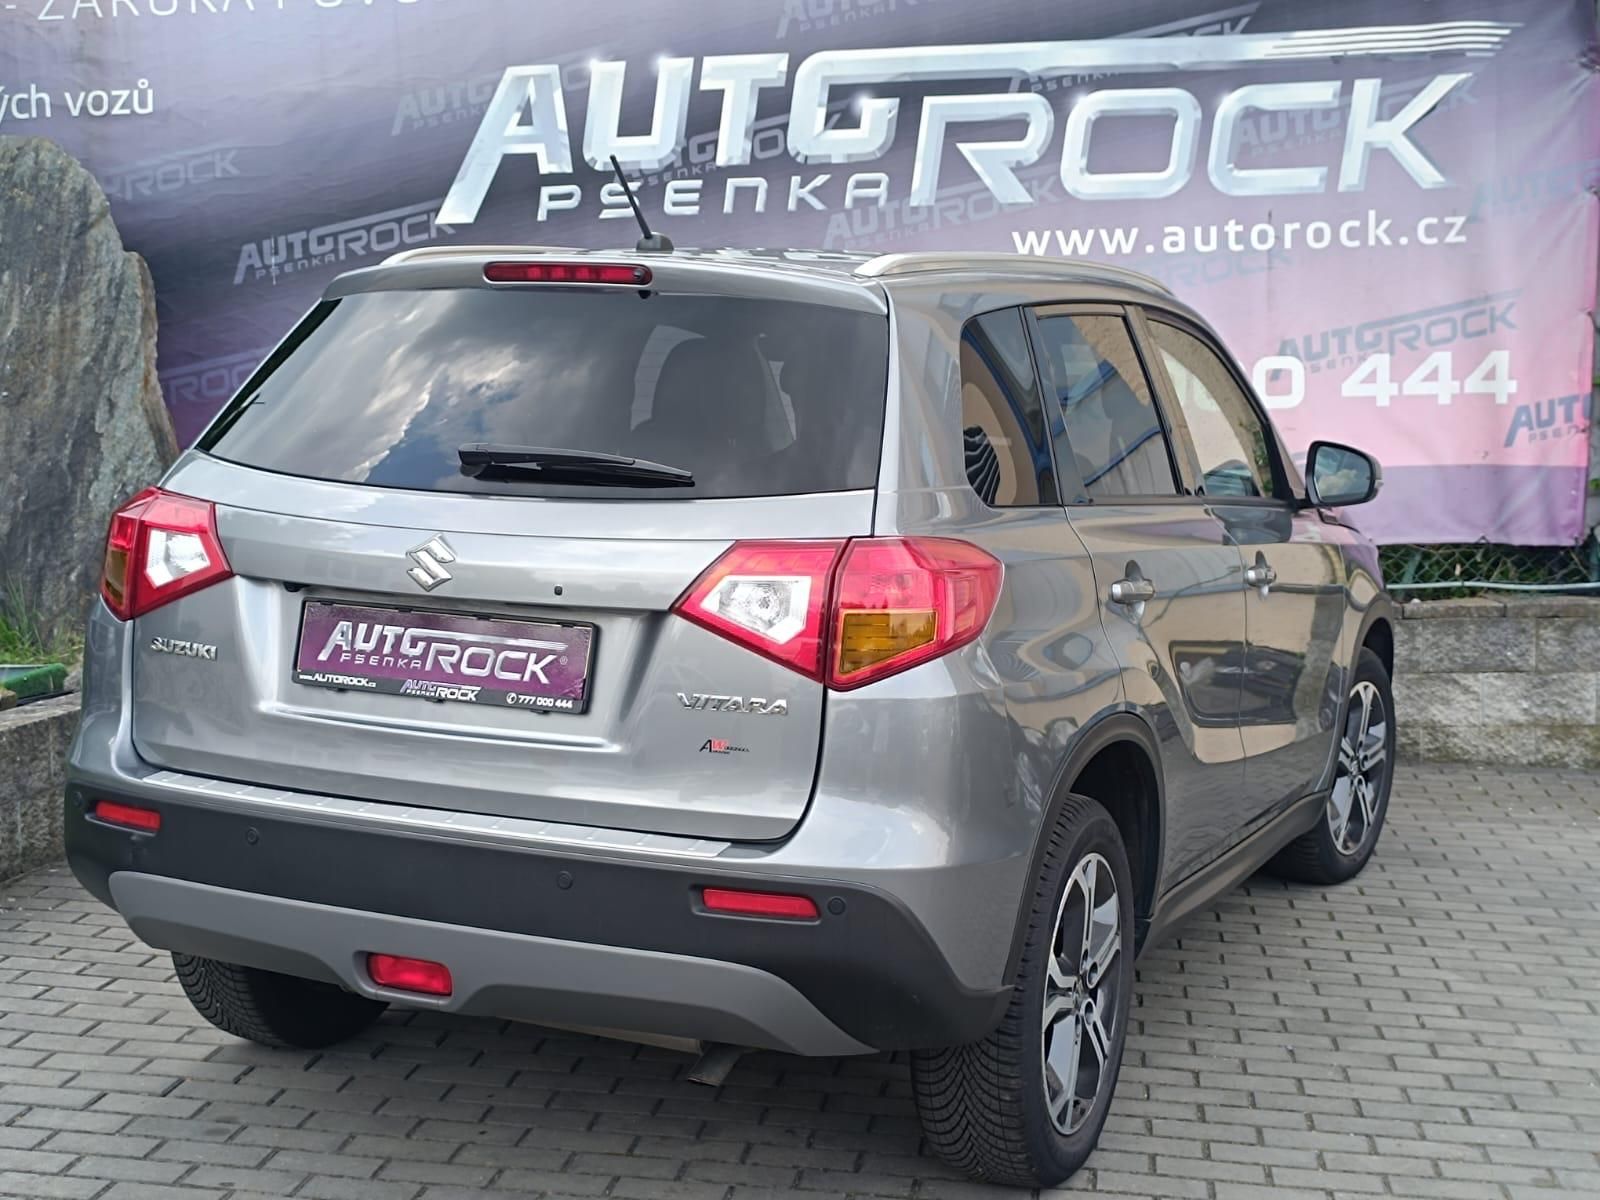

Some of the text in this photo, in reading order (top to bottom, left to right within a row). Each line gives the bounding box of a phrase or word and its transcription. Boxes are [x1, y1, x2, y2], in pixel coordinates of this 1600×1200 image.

[64, 78, 154, 116] vozů
[536, 172, 890, 222] PSENKA
[1011, 208, 1468, 257] www.autorock.cz
[1341, 350, 1517, 407] 444
[150, 636, 218, 661] SUZUKI
[519, 693, 573, 709] 777 000 444
[676, 692, 788, 716] VITARA
